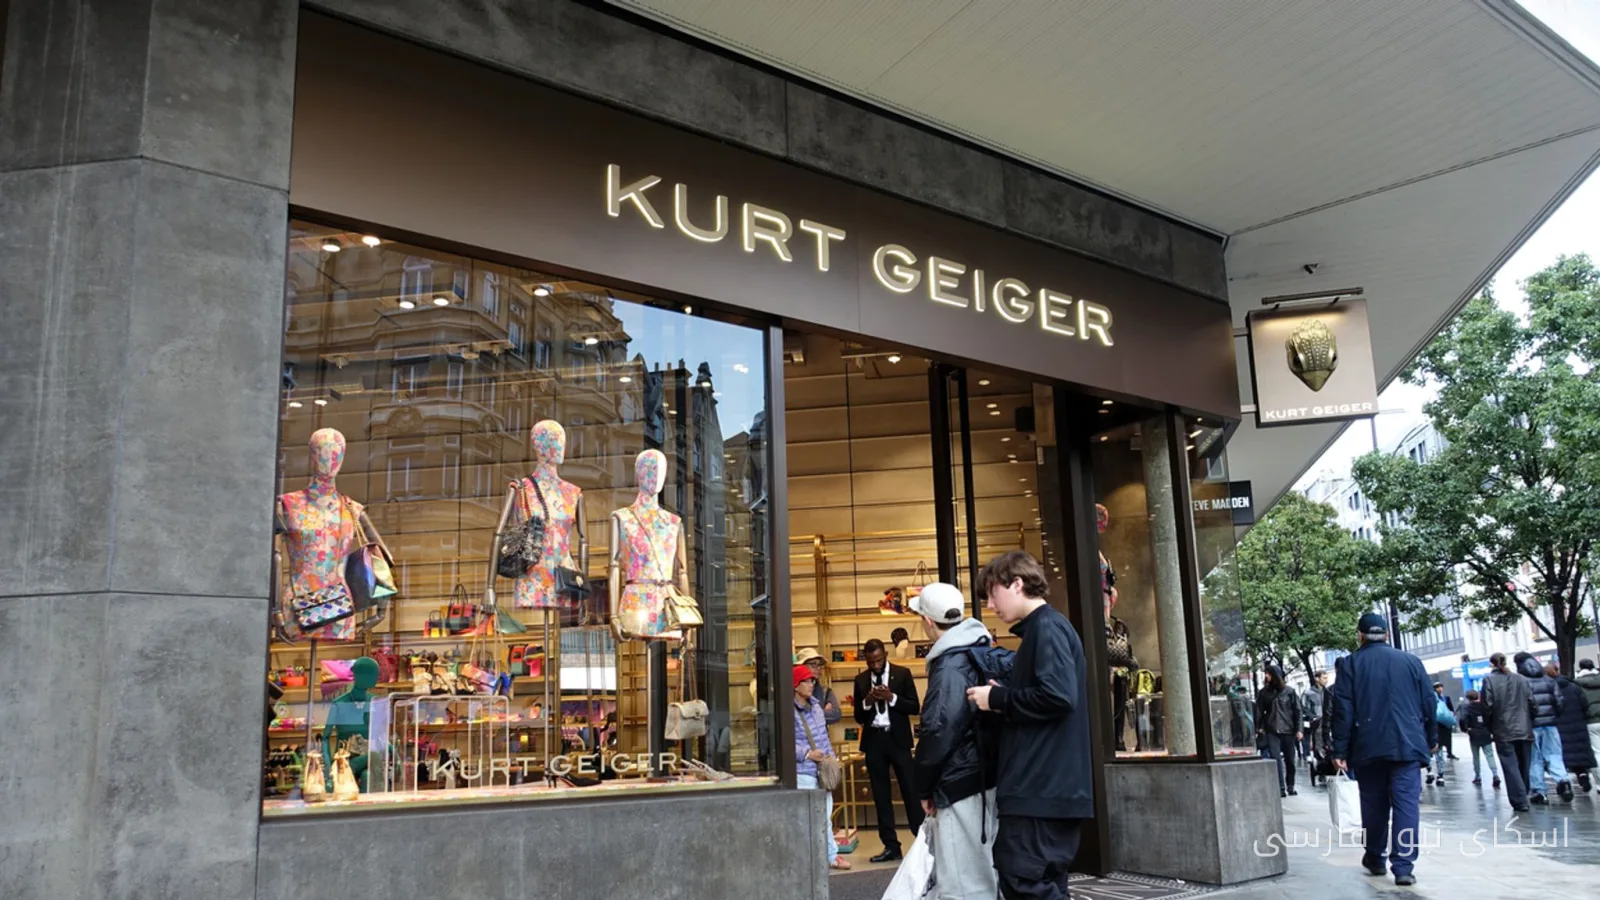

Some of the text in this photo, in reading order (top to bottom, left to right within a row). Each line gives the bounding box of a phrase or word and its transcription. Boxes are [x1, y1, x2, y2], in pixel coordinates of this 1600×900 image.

[606, 163, 1115, 347] KURT GEIGER
[1265, 402, 1373, 419] KURT GEIGER
[432, 752, 677, 781] KURT GEIGER
